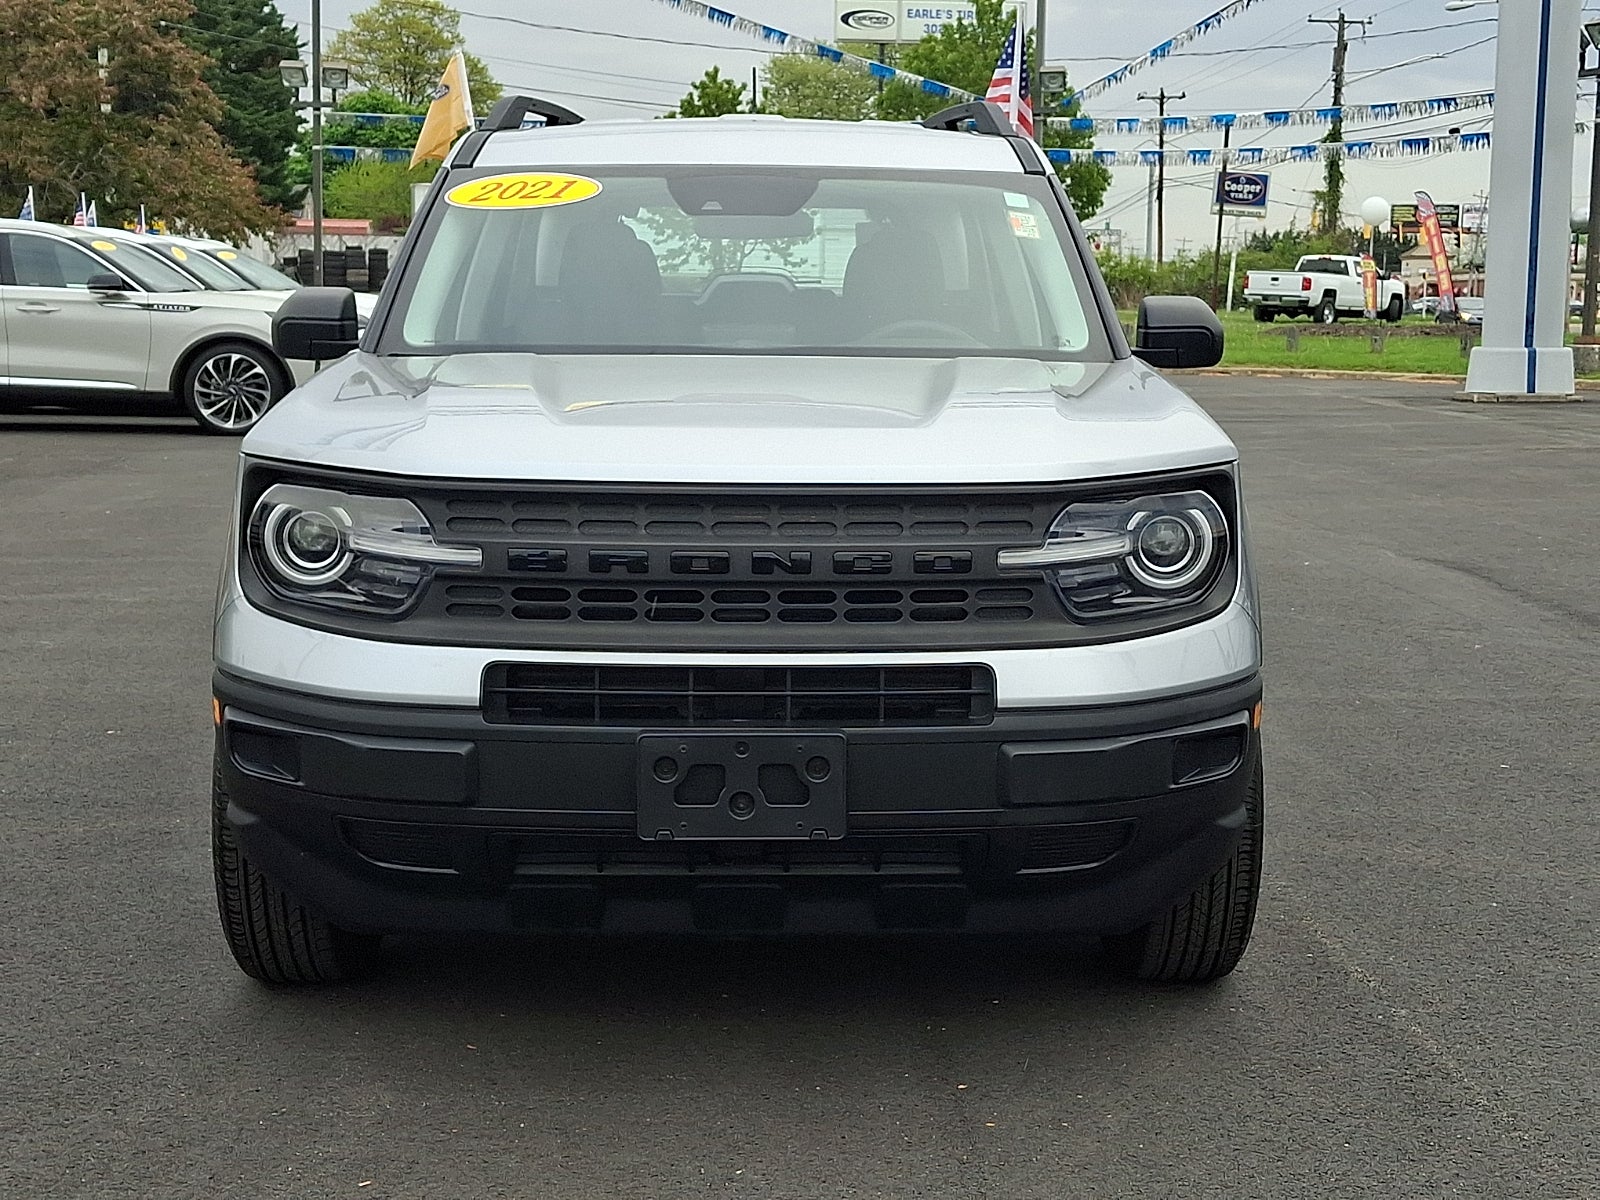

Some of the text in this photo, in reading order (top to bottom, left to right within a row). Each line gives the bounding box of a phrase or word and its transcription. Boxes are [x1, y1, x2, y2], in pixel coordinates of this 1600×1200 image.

[907, 9, 974, 20] EARLE'S TIR
[469, 180, 578, 203] 2021
[1224, 181, 1262, 193] Cooper
[507, 548, 973, 575] BRONCO
